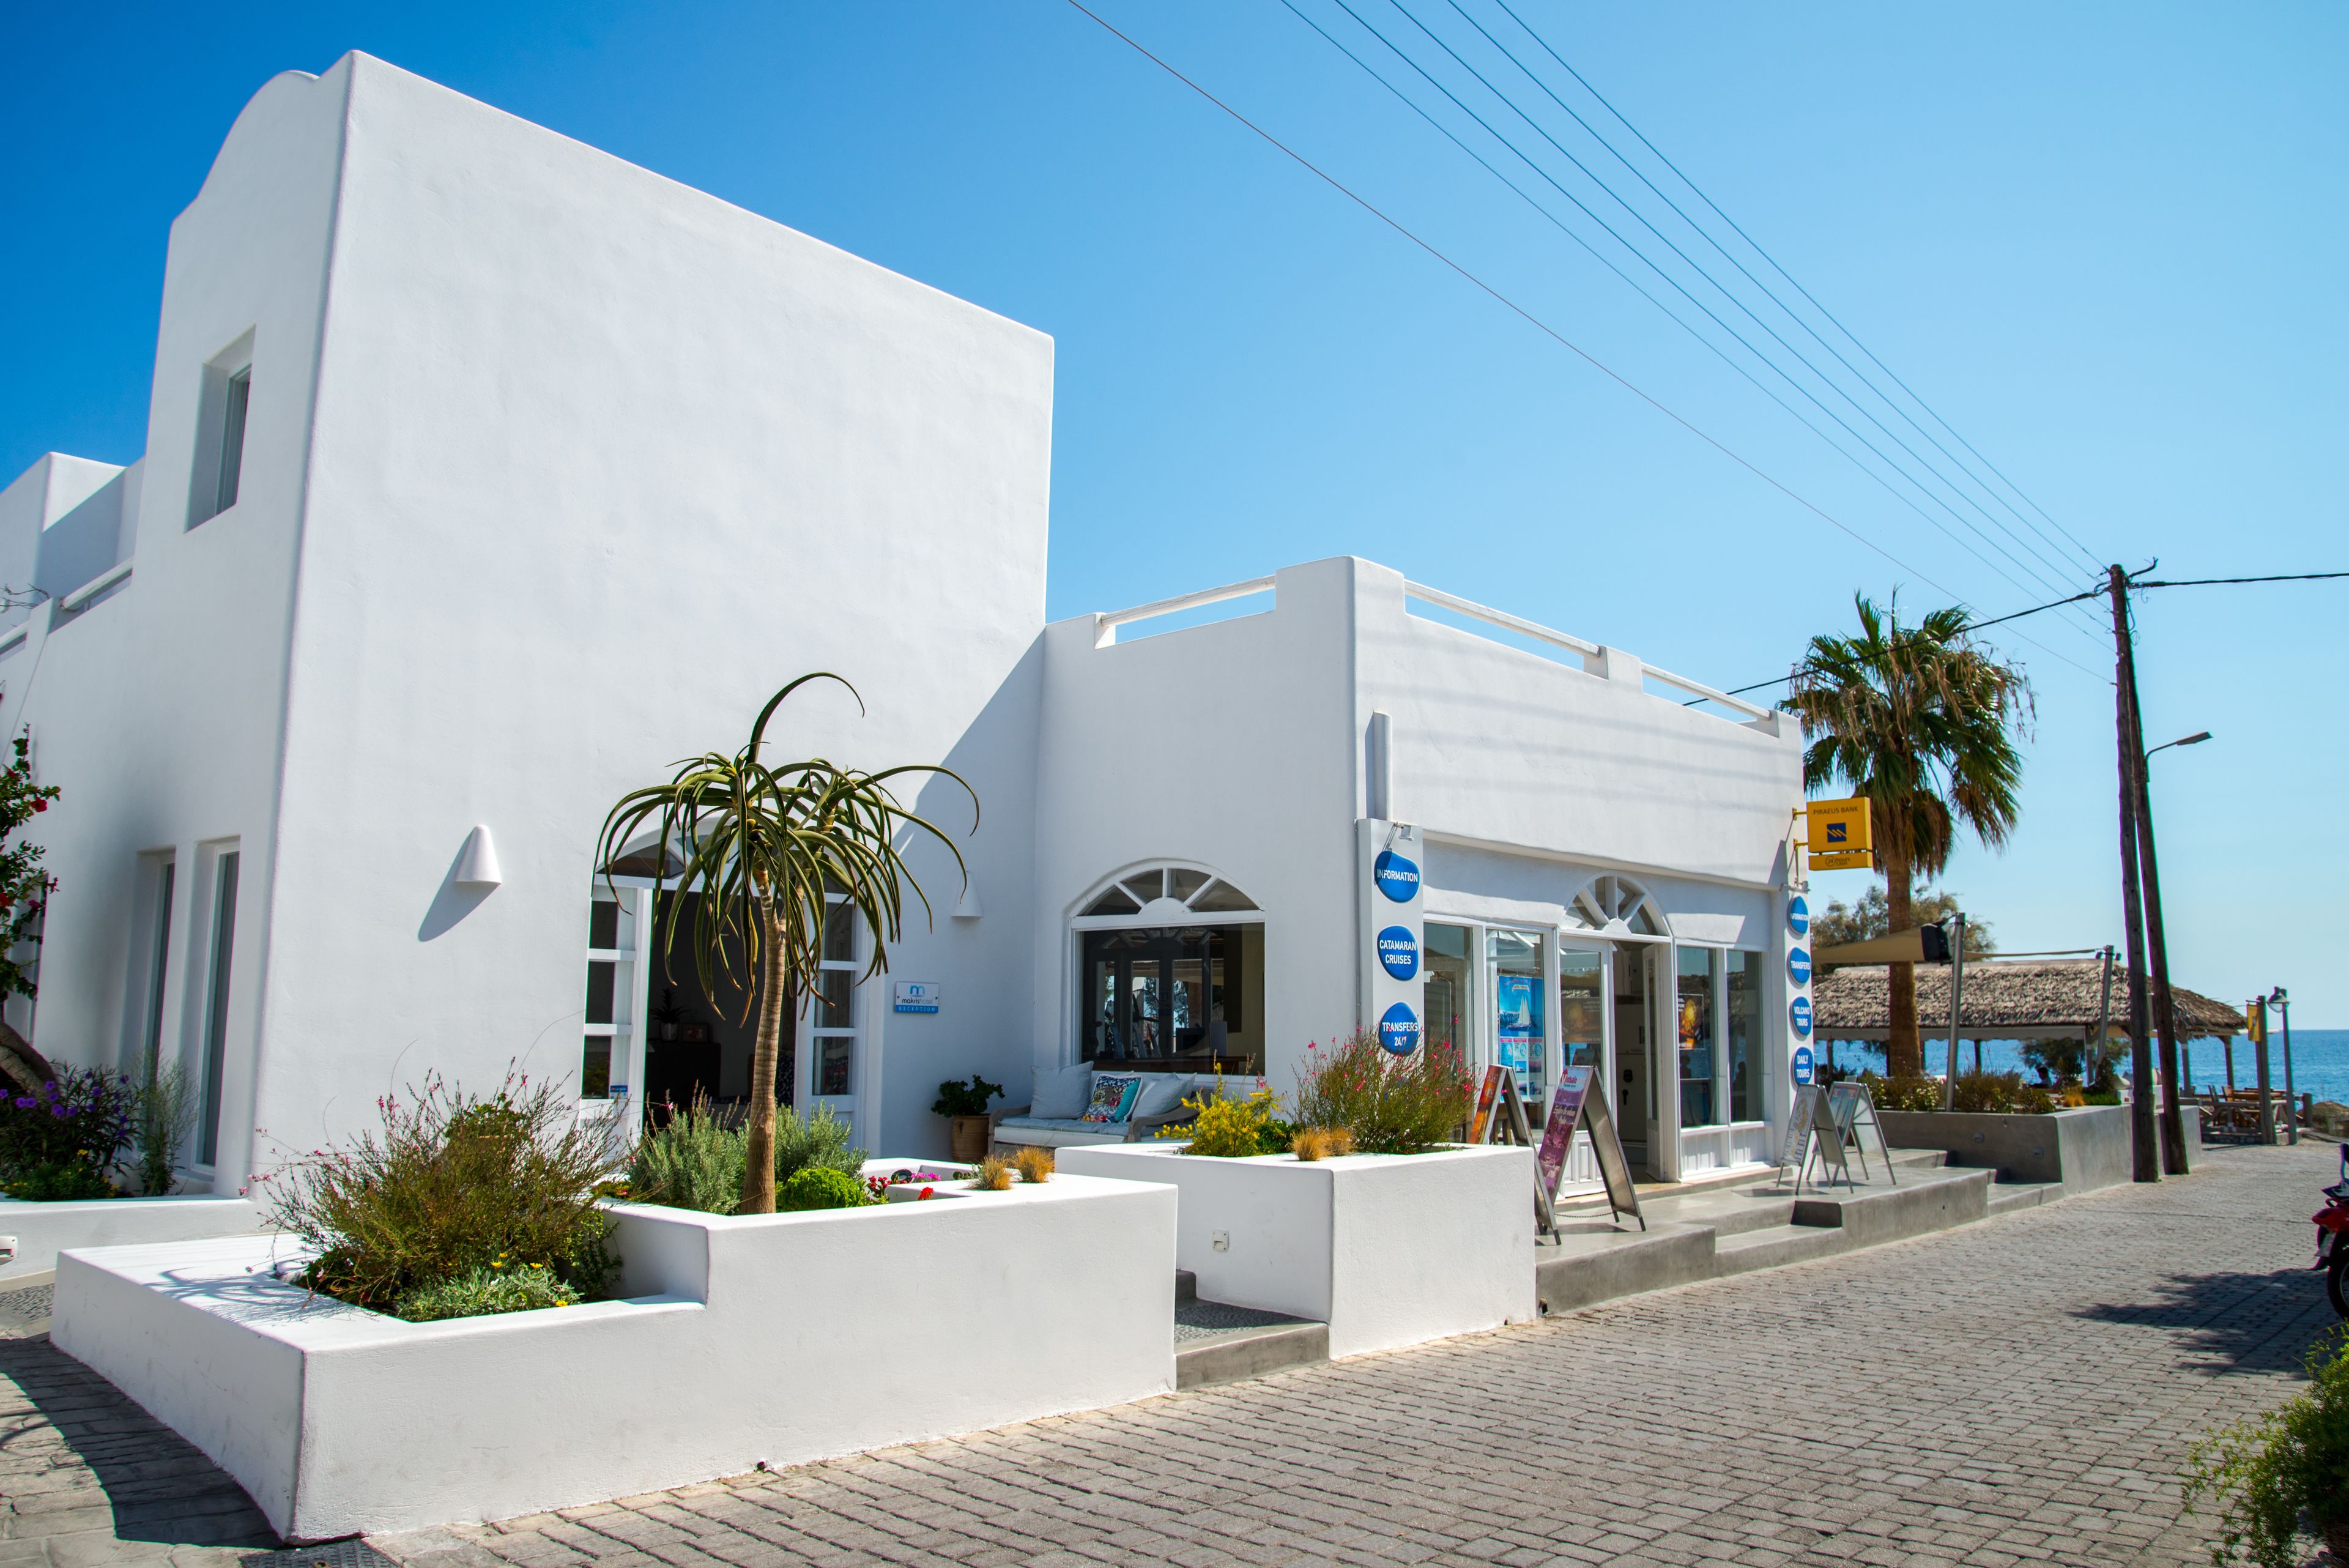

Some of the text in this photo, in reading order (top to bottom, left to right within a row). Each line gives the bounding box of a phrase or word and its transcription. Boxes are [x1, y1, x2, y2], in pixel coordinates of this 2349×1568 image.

[1377, 868, 1418, 883] INFORMATION
[1379, 939, 1417, 951] CATAMARAN
[1385, 954, 1411, 965] CRUISES
[1791, 960, 1811, 970] TRANSFERS
[1794, 1006, 1809, 1015] VOLCANO
[1382, 1021, 1418, 1032] TRANSFERS
[1797, 1018, 1808, 1027] TOURS
[1797, 1055, 1808, 1065] DAILY
[1797, 1069, 1810, 1078] TOURS
